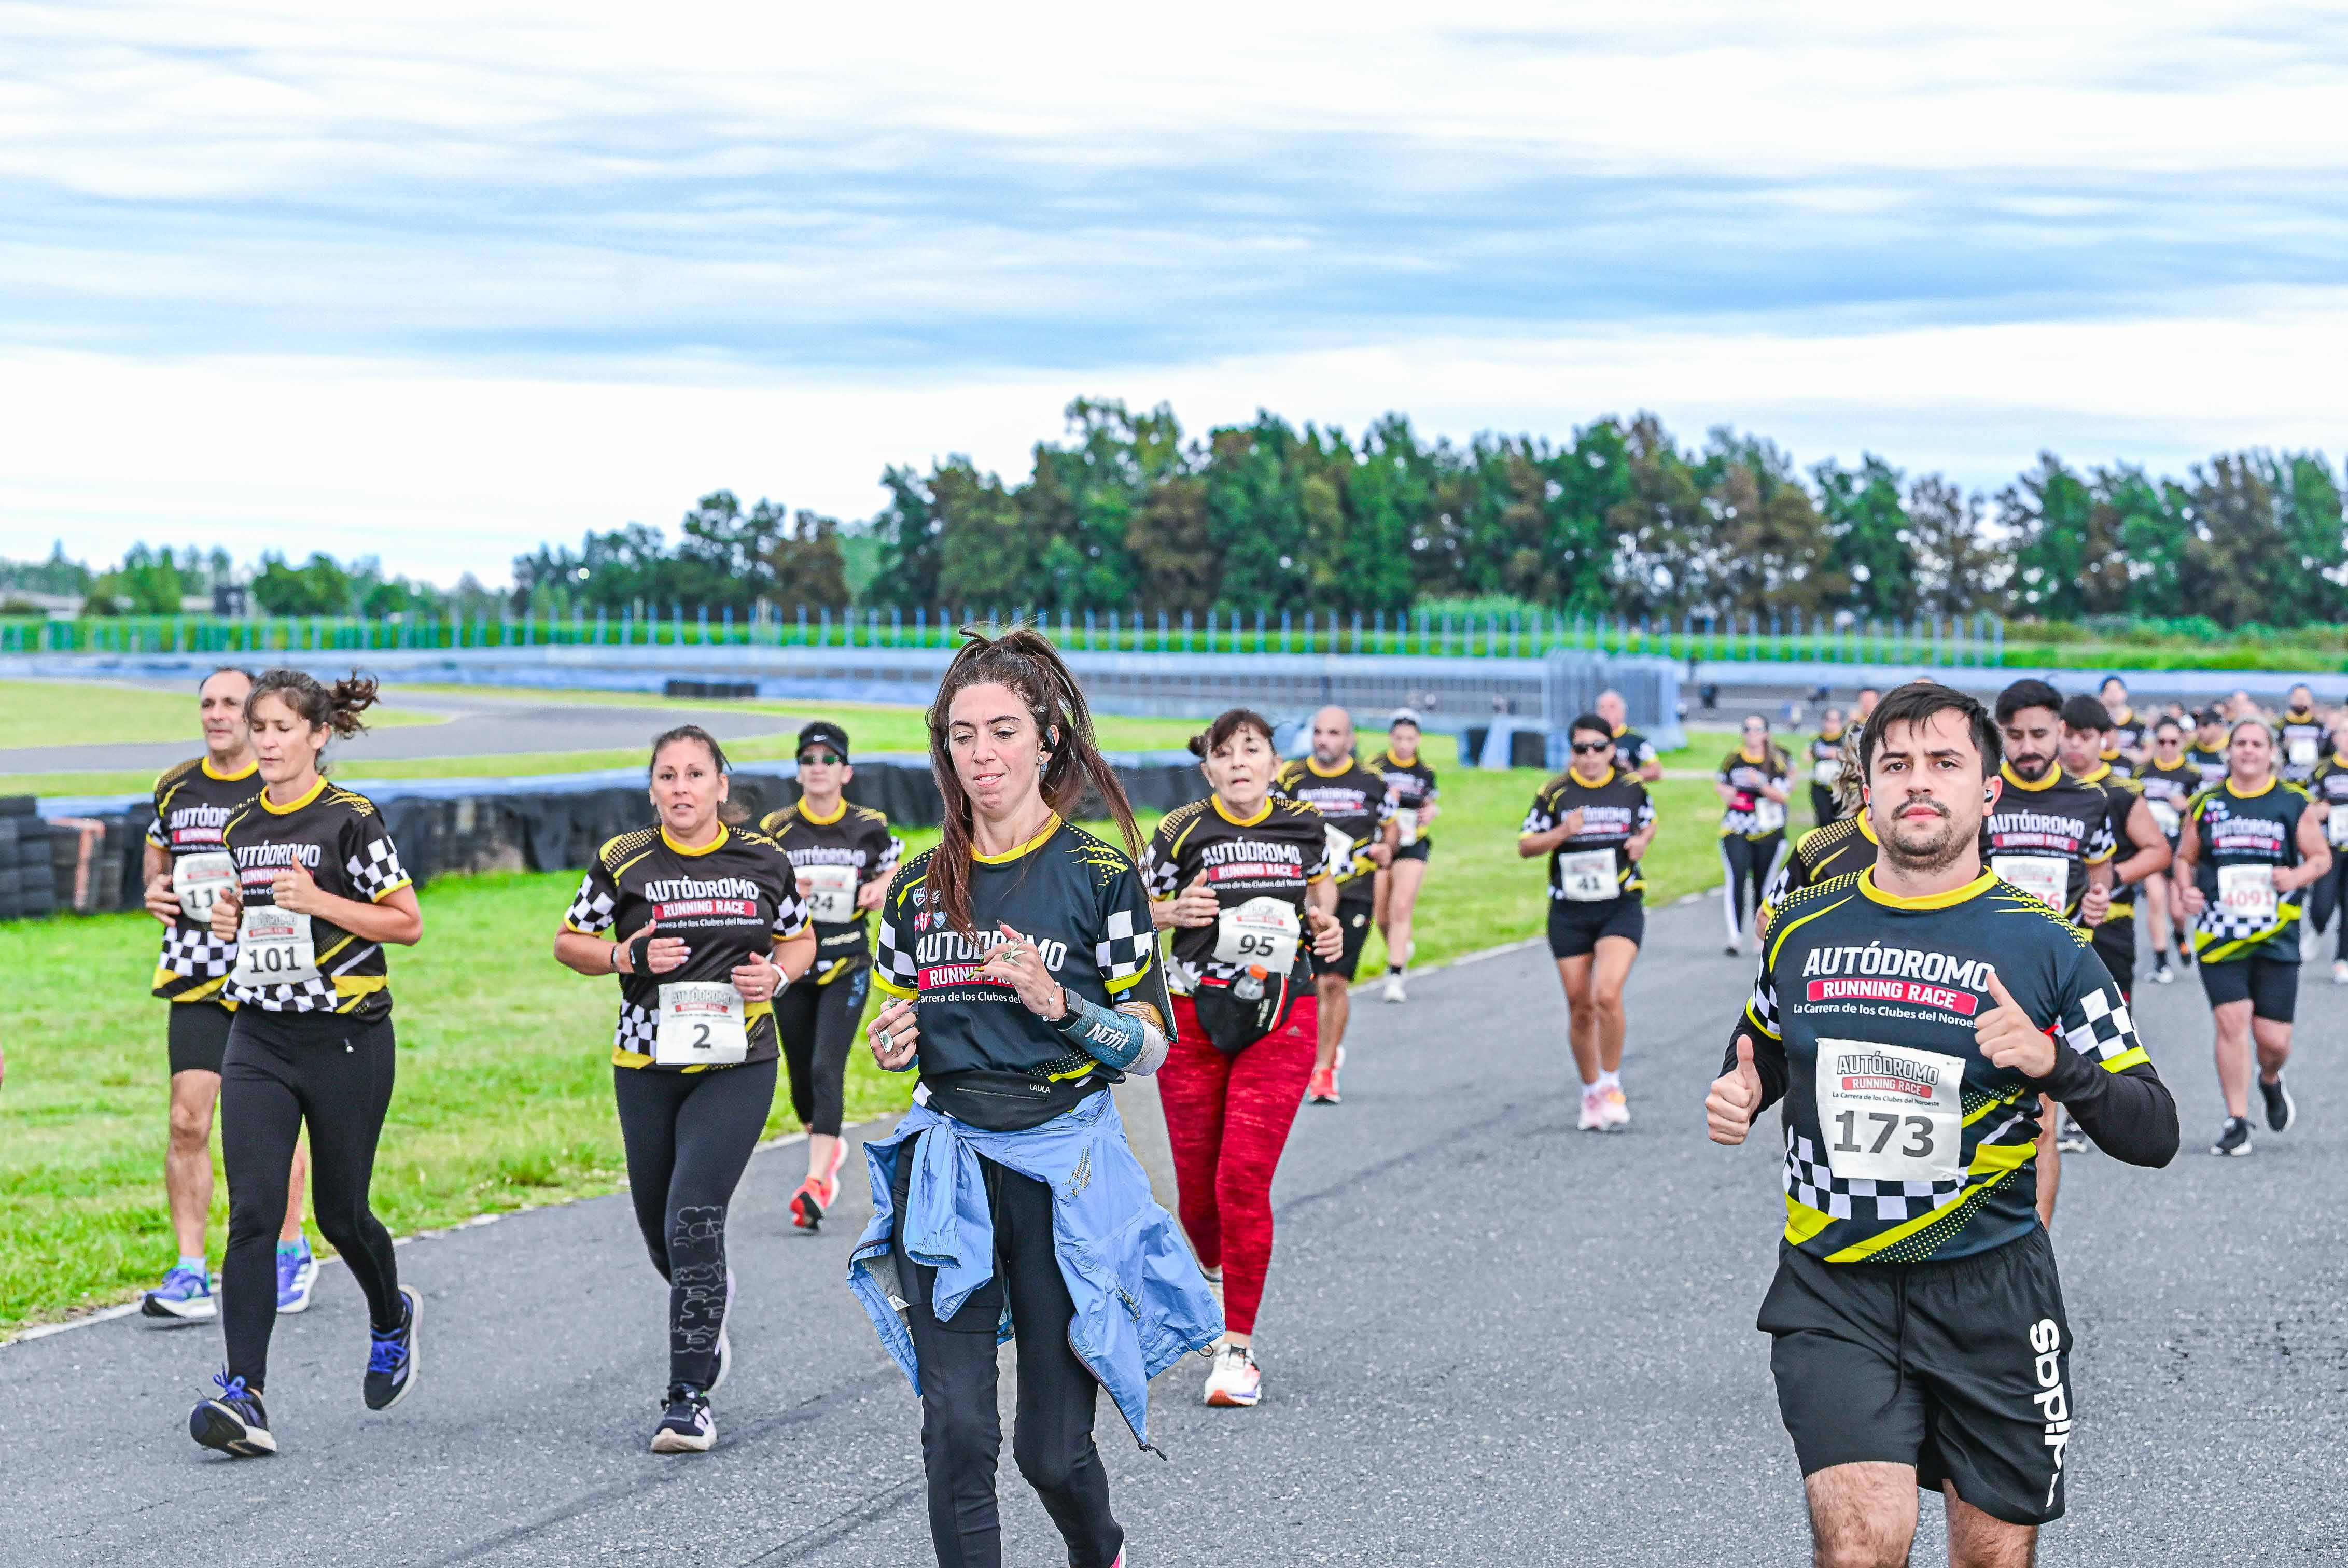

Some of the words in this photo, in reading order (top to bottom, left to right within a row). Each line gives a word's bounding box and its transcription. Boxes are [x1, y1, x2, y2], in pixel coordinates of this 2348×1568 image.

[1987, 808, 2086, 840] AUTÓDROMO
[1201, 836, 1303, 867] AUTÓDROMO
[644, 875, 760, 903] AUTÓDROMO
[662, 900, 713, 918] RUNNING
[715, 900, 745, 915] RACE
[1238, 934, 1275, 957] 95
[249, 946, 301, 973] 101
[1801, 940, 1996, 993] AUTÓDROMO
[948, 991, 959, 1002] de
[962, 991, 975, 1001] los
[977, 991, 1007, 1002] Clubes
[1009, 993, 1021, 1004] del
[1823, 981, 1903, 998] RUNNING
[1908, 985, 1958, 1009] RACE
[1793, 1003, 1803, 1013] La
[1804, 1003, 1840, 1013] Carrera
[1842, 1003, 1857, 1013] de
[1859, 1004, 1876, 1015] los
[1878, 1006, 1916, 1019] Clubes
[1918, 1010, 1936, 1021] del
[693, 1024, 711, 1048] 2
[1837, 1051, 1939, 1085] AUTÓDROMO
[1029, 1084, 1050, 1094] LAULA
[1852, 1078, 1896, 1089] RUNNING
[1898, 1081, 1921, 1096] RACE
[1834, 1110, 1934, 1158] 173
